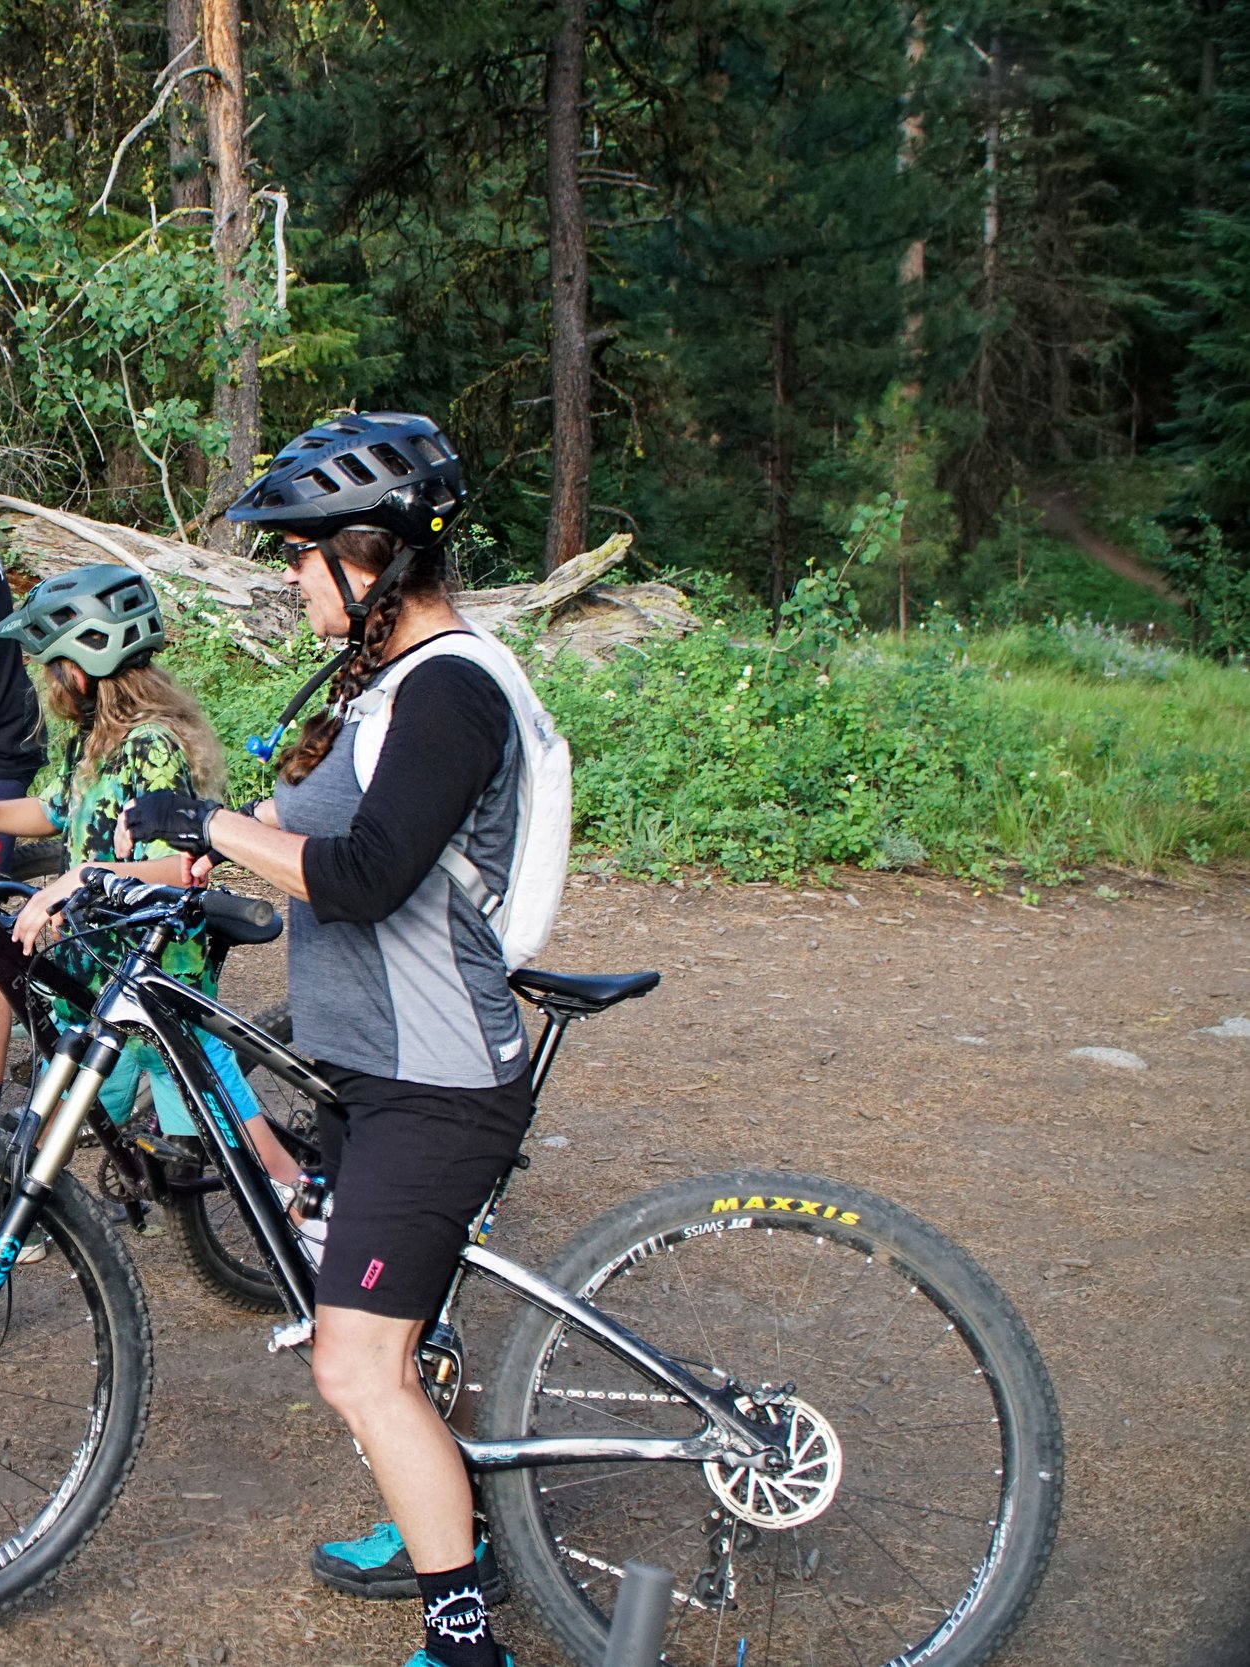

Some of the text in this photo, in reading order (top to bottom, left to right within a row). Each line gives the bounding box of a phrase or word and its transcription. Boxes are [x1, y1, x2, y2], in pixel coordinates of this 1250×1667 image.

[711, 1196, 861, 1226] MAXXIS
[683, 1217, 753, 1239] DT SWISS
